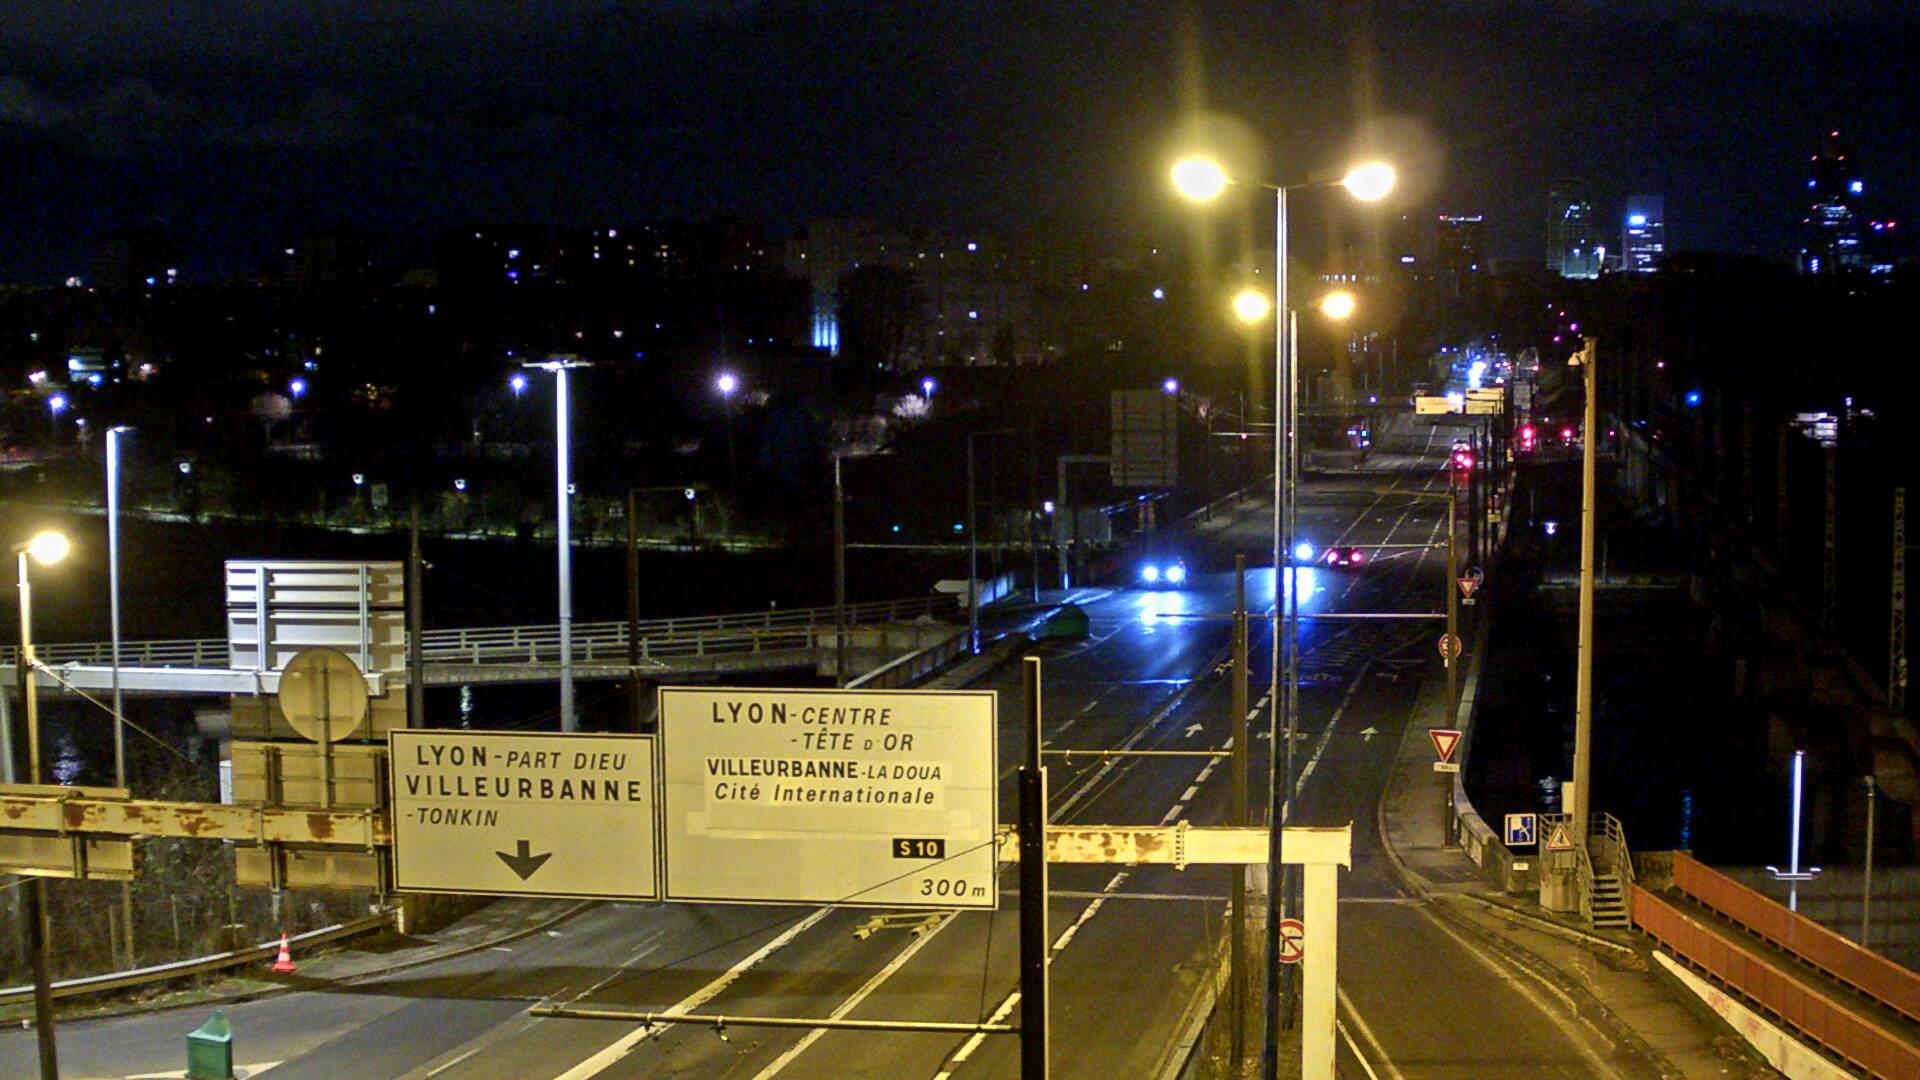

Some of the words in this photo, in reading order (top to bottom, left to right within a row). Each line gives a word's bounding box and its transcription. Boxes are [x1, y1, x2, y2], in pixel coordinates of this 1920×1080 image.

[573, 752, 627, 770] DIEU
[893, 765, 942, 780] DOUA
[405, 775, 642, 802] VILLEURBANNE
[714, 782, 761, 800] Cité
[774, 784, 935, 805] Internationale
[920, 878, 967, 897] 300
[972, 886, 986, 898] m
